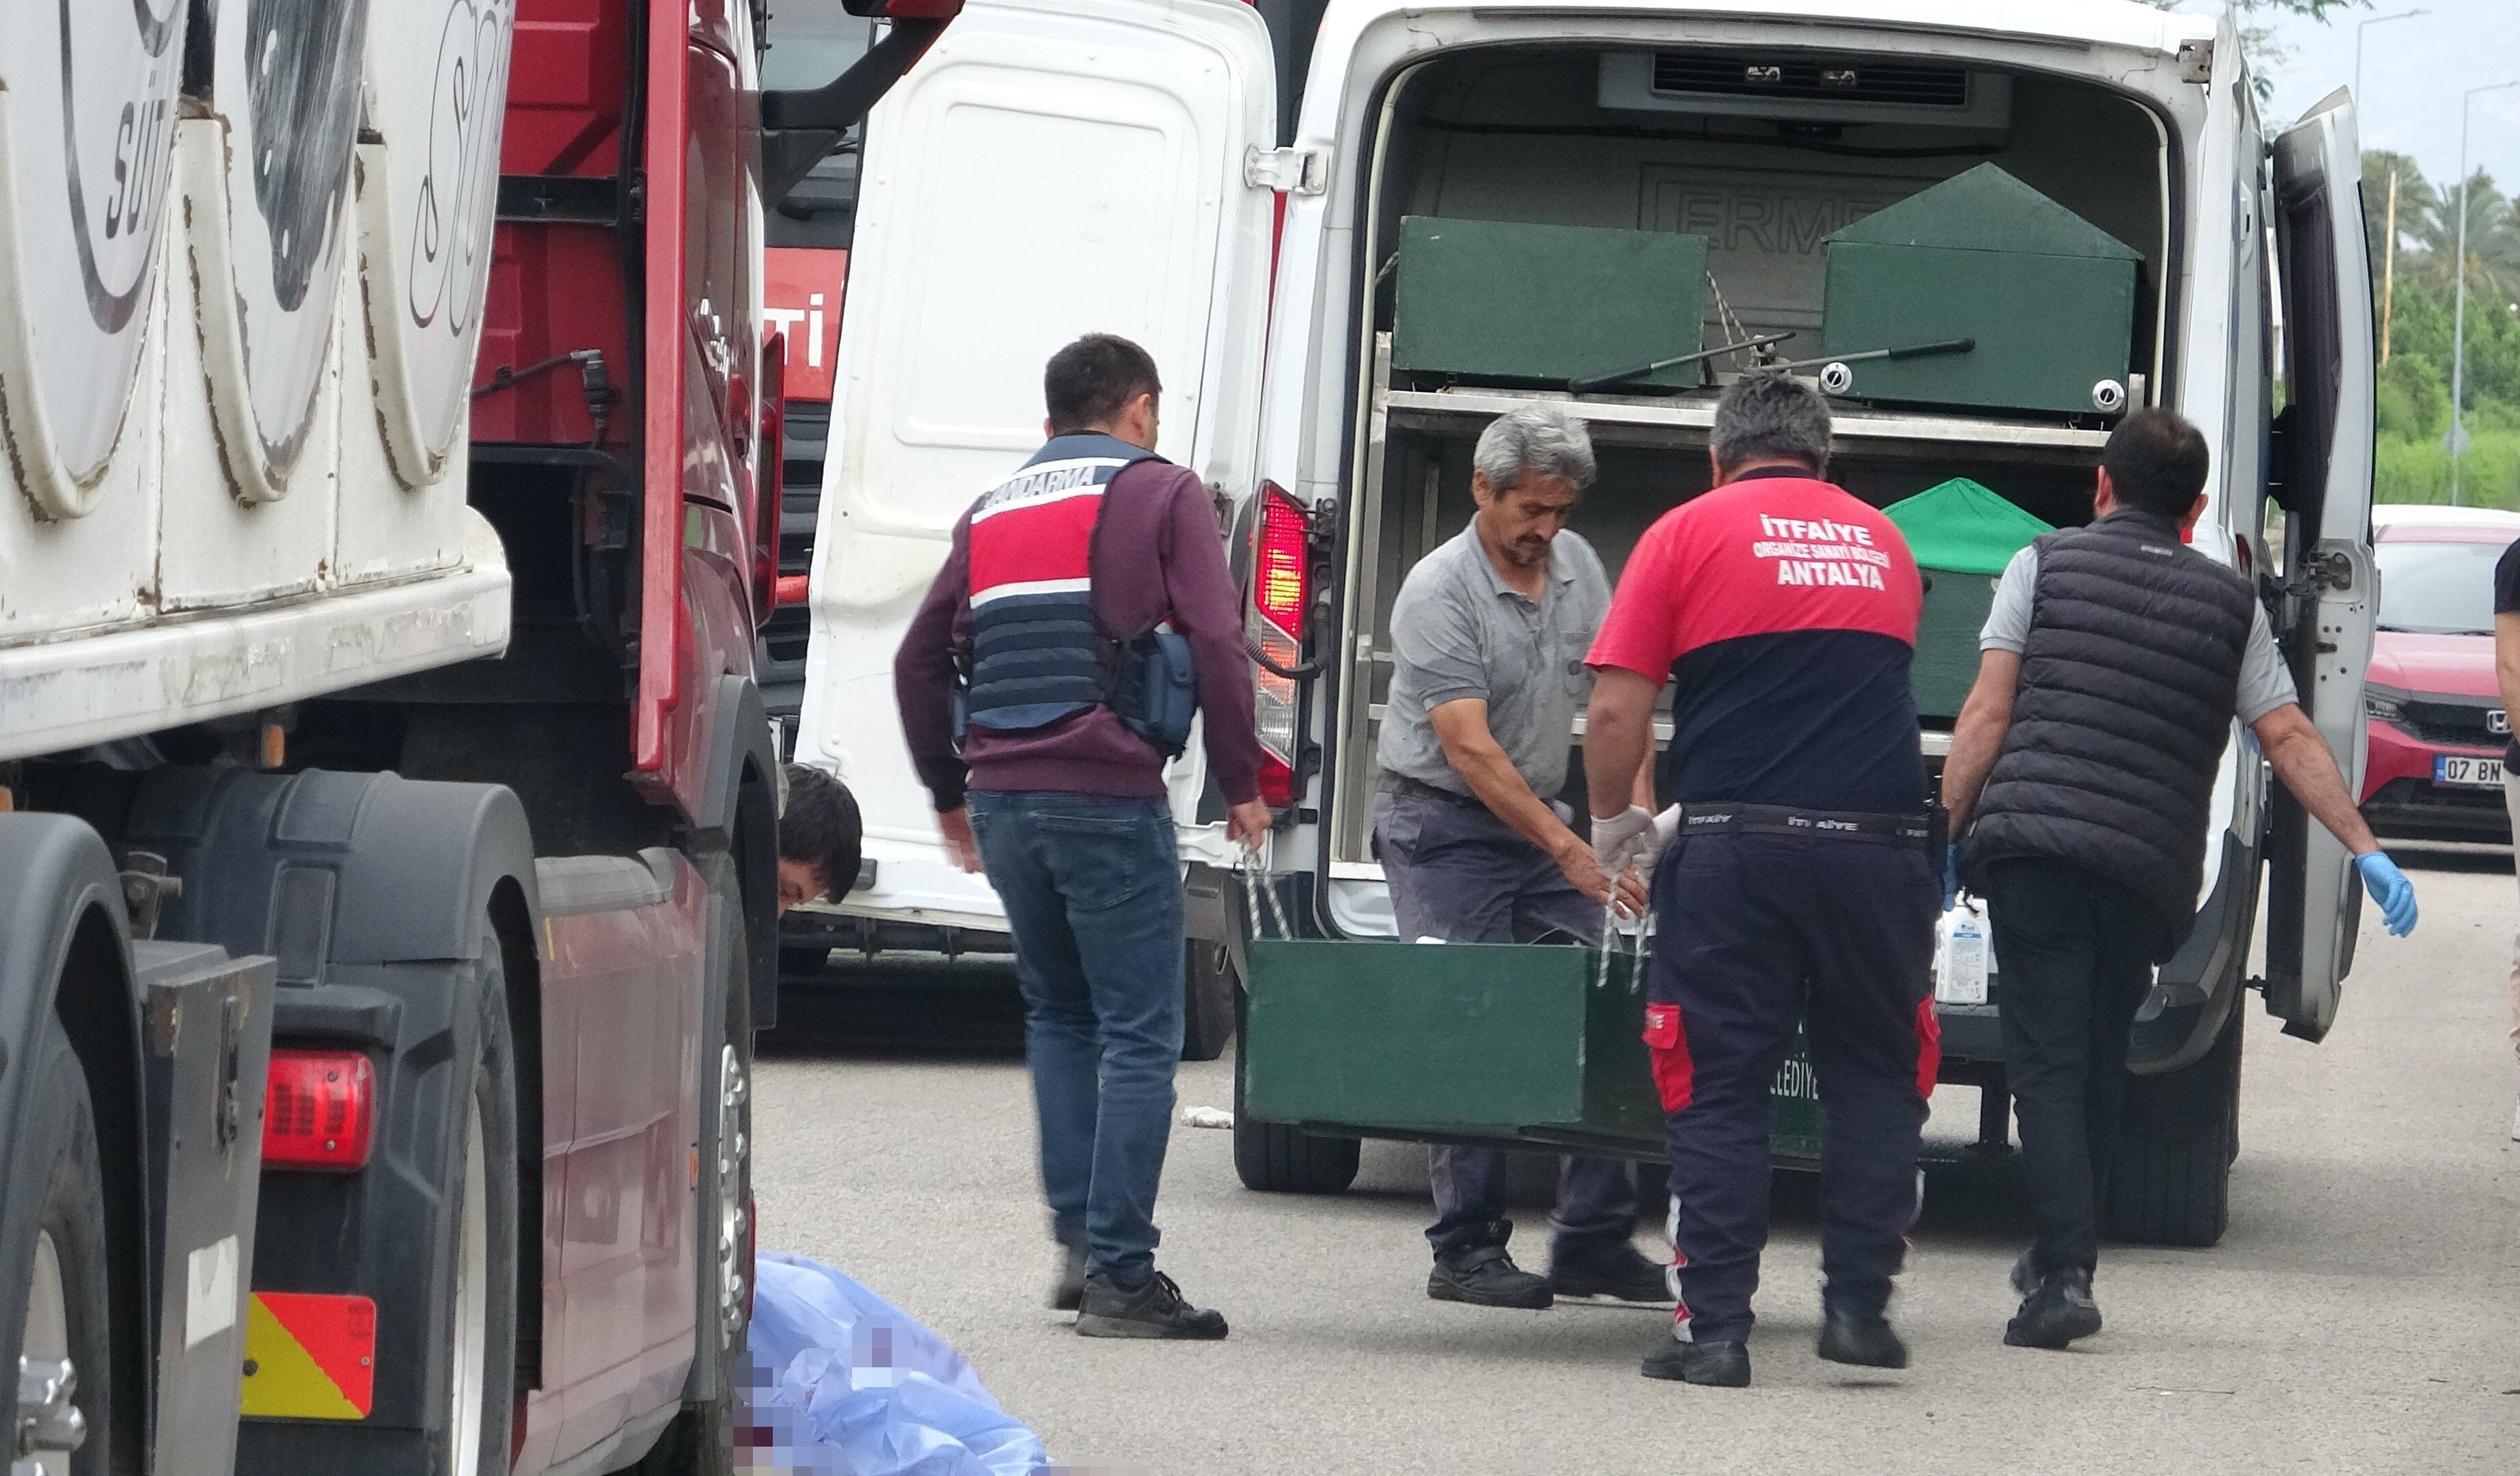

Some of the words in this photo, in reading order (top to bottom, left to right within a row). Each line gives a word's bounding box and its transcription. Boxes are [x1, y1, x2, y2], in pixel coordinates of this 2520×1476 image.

[1759, 513, 1874, 546] İTFAİYE
[1777, 559, 1885, 591] ANTALYA
[2448, 761, 2470, 780] 07
